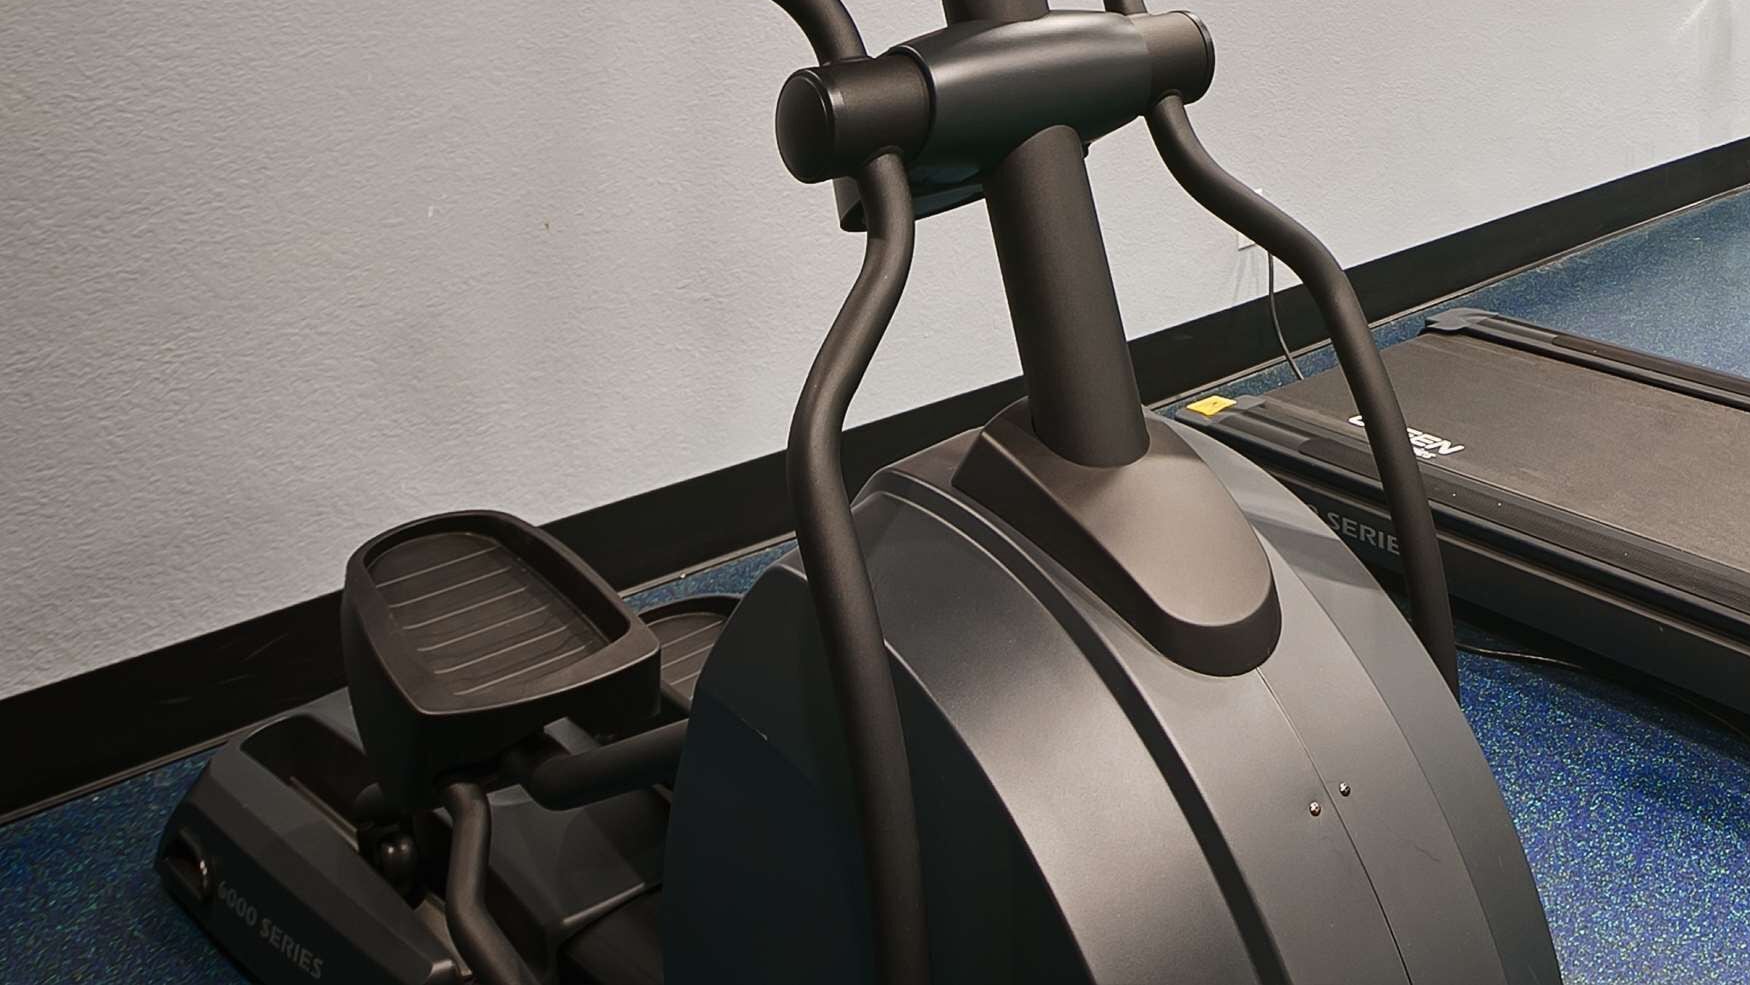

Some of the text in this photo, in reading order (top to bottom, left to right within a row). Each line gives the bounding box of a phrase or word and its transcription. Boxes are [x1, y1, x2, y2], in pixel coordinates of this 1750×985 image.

[1328, 512, 1400, 556] SERIE
[217, 881, 323, 979] 6000 SERIES
